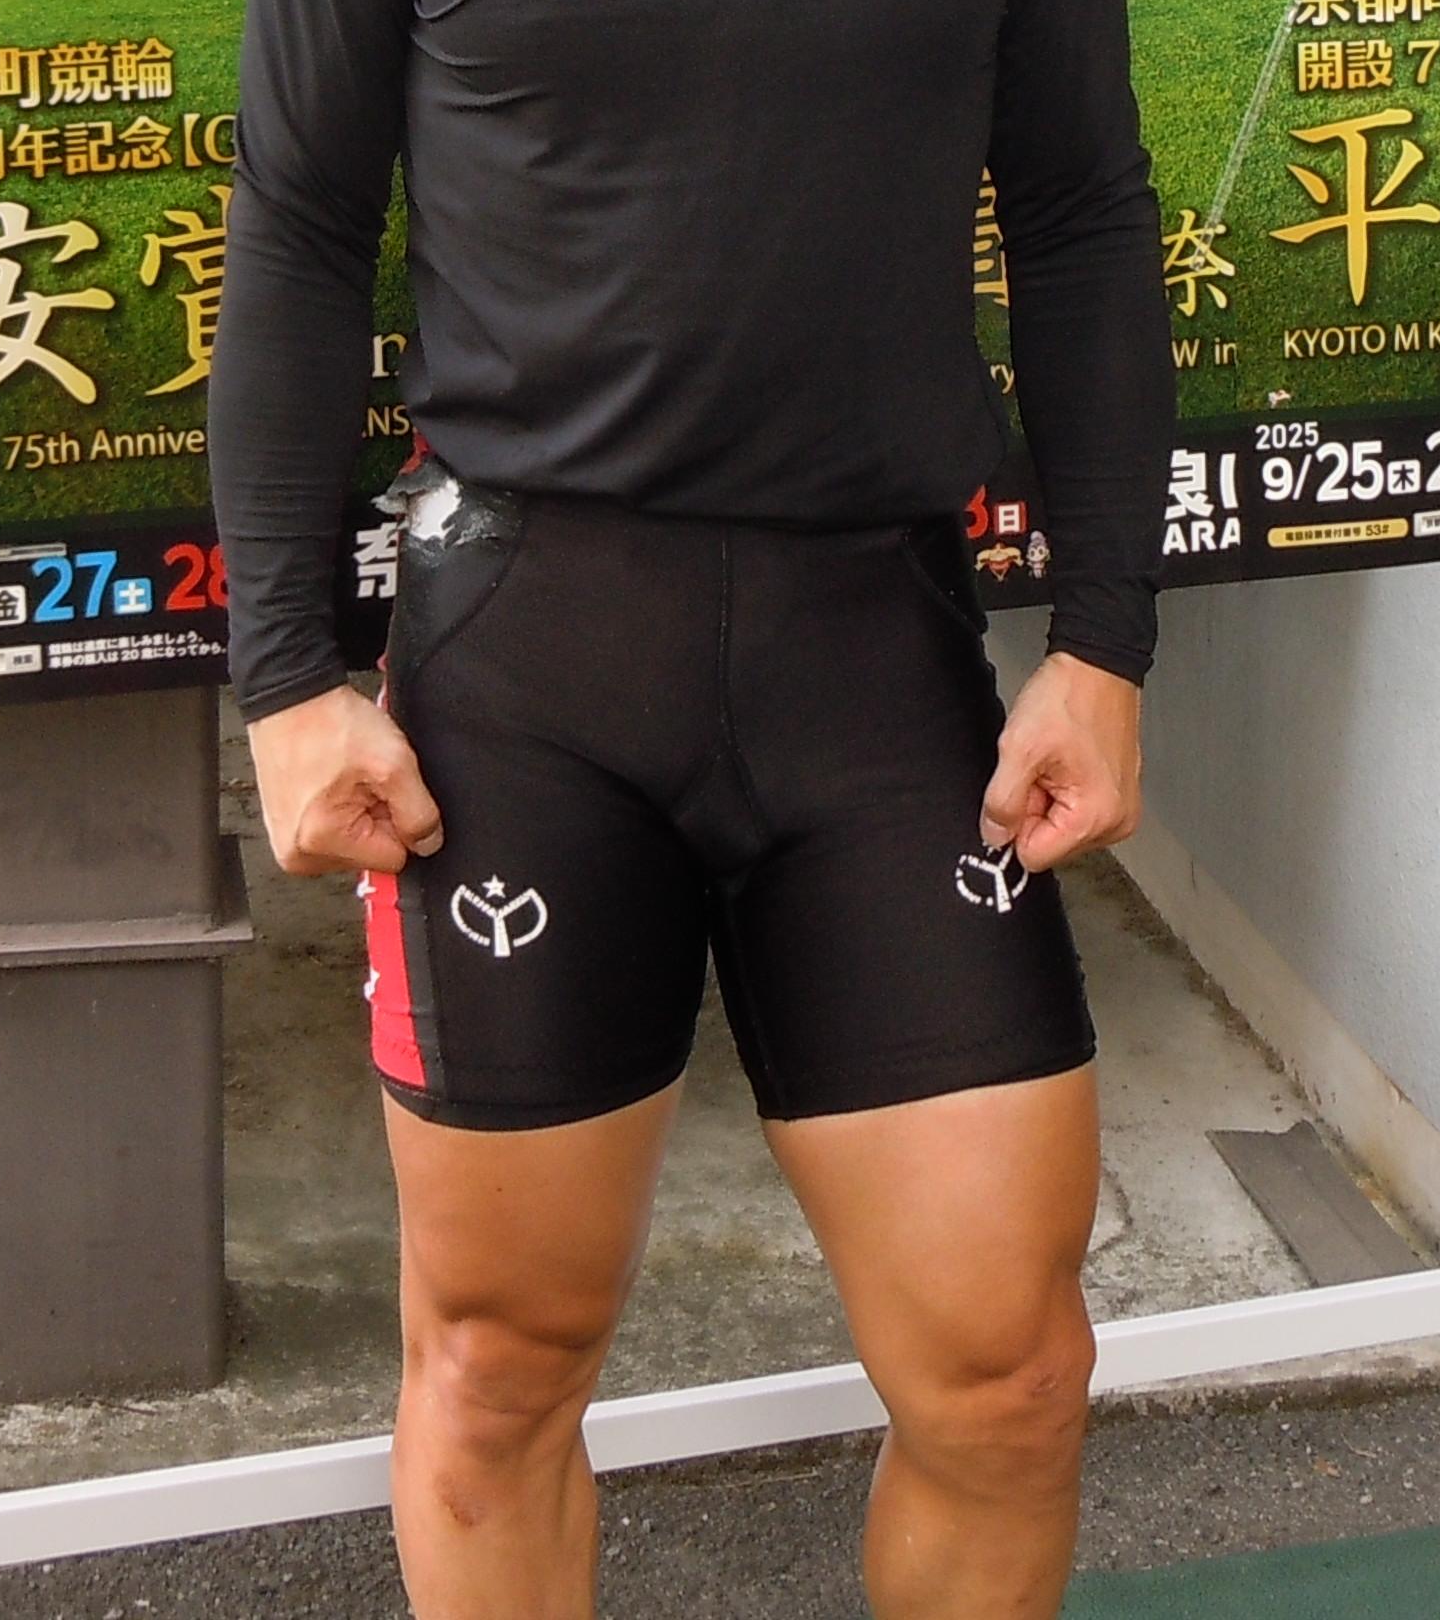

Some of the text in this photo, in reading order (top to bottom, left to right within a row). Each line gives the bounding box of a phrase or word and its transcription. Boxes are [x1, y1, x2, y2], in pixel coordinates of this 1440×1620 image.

[1161, 209, 1236, 317] 奈
[1283, 324, 1387, 359] KYOTO
[1393, 322, 1420, 352] M
[2, 431, 80, 471] 75th
[90, 425, 206, 460] Annive
[1255, 421, 1319, 451] 2025
[1263, 441, 1383, 502] 9/25
[1162, 516, 1242, 556] ARA
[31, 551, 118, 624] 27
